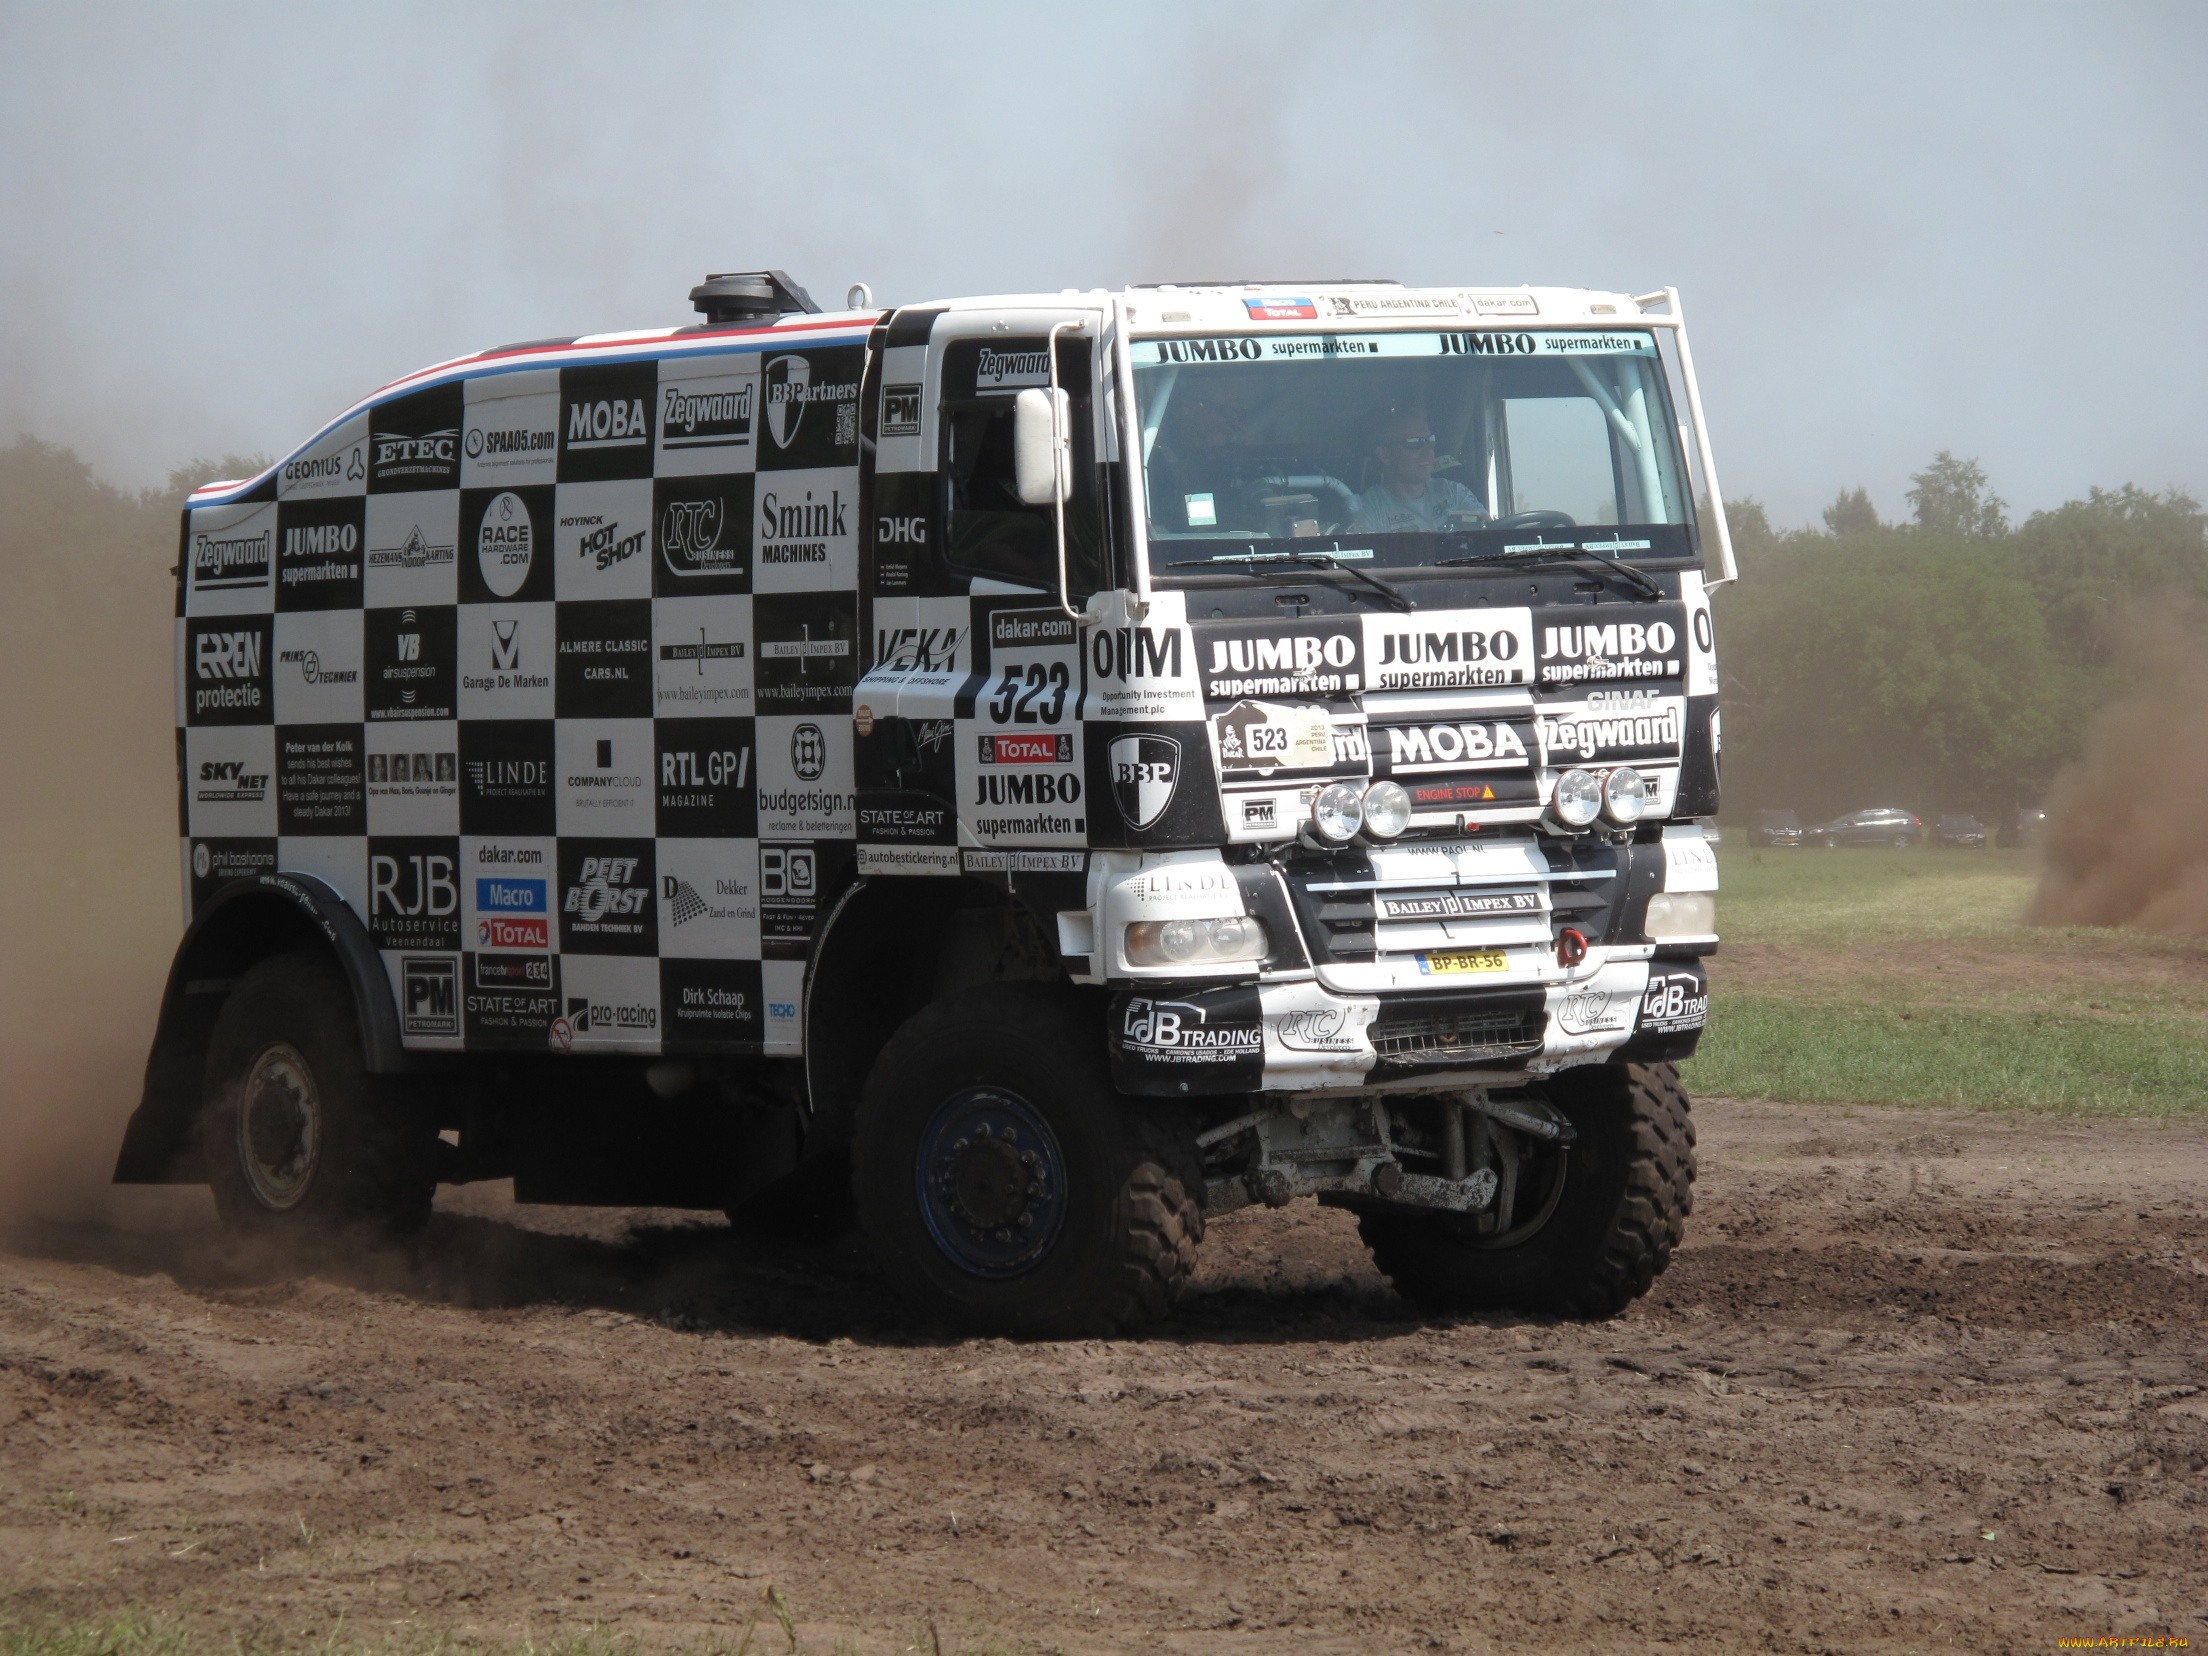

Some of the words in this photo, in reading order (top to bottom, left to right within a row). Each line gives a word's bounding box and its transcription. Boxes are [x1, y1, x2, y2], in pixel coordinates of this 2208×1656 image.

[1354, 299, 1378, 309] PERU
[1380, 299, 1430, 309] ARGENTINA
[1432, 299, 1457, 308] CHILE
[1477, 298, 1532, 308] dakar.com
[1156, 339, 1262, 364] JUMBO
[1272, 340, 1365, 357] supermarkten
[1439, 334, 1536, 355] JUMBO
[1545, 336, 1631, 351] supermarkten
[665, 384, 752, 432] Zegwaard
[884, 396, 919, 423] PM
[568, 399, 646, 439] MOBA
[375, 439, 456, 465] ETEC
[560, 515, 603, 527] HOYINCK
[762, 491, 847, 539] Smink
[482, 525, 528, 543] RACE
[667, 500, 715, 555] RTC
[283, 524, 357, 557] JUMBO
[482, 544, 528, 553] HARDWARE
[580, 522, 618, 557] HOT
[196, 530, 270, 575] Zegwaard
[401, 557, 426, 568] INDOOR
[426, 549, 454, 560] KARTING
[500, 553, 529, 565] .COM
[596, 530, 646, 570] SHOT
[762, 544, 826, 563] MACHINES
[282, 562, 348, 587] supermarkten
[996, 619, 1072, 639] dakar.com
[397, 634, 421, 661] VB
[559, 641, 602, 653] ALMERE
[605, 639, 648, 652] CLASSIC
[774, 645, 799, 655] BAILEY
[810, 644, 833, 654] IMPEX
[835, 642, 846, 653] BV
[1378, 630, 1519, 665] JUMBO
[1541, 622, 1676, 658] JUMBO
[196, 631, 261, 679] ERREN
[672, 647, 697, 658] BAILEY
[706, 646, 729, 657] IMPEX
[730, 645, 742, 656] BV
[876, 628, 957, 672] VEKA
[1209, 635, 1356, 673] JUMBO
[280, 650, 304, 663] PRINS
[319, 671, 357, 684] TECHNIEK
[383, 664, 436, 681] airsuspension
[584, 668, 629, 680] CARS.NL
[1542, 657, 1663, 682] supermarkten
[463, 675, 495, 691] Garage
[498, 675, 511, 688] De
[513, 675, 549, 688] Marken
[1210, 674, 1341, 697] supermarkten
[1379, 665, 1505, 689] supermarkten
[197, 683, 261, 713] protectie
[657, 686, 749, 703] www.baileyimpex.com
[757, 683, 853, 702] www.baileyimpex.com
[990, 662, 1069, 725] 523
[1102, 690, 1141, 701] Opportunity
[1143, 690, 1195, 699] Investment
[1588, 689, 1659, 712] GINAF
[1101, 706, 1148, 716] Management
[1151, 706, 1165, 715] plc
[1253, 728, 1288, 751] 523
[1385, 722, 1527, 763] MOBA
[1544, 707, 1679, 759] Zegwaard
[285, 742, 305, 752] Peter
[307, 744, 320, 752] van
[322, 741, 334, 752] der
[336, 741, 352, 751] Kolk
[998, 740, 1053, 757] TOTAL
[287, 759, 305, 768] sends
[307, 758, 316, 768] his
[317, 758, 330, 768] best
[331, 758, 352, 767] wishes
[486, 761, 547, 784] LINDE
[662, 752, 704, 786] RTL
[200, 762, 244, 781] SKY
[237, 775, 269, 789] NET
[297, 774, 306, 784] his
[307, 774, 326, 784] Dakar
[568, 776, 642, 788] COMPANYCLOUD
[198, 792, 234, 800] WORLDWIDE
[975, 773, 1081, 805] JUMBO
[1417, 788, 1453, 800] ENGINE
[1456, 787, 1480, 798] STOP
[663, 795, 714, 807] MAGAZINE
[293, 806, 313, 819] steady
[314, 806, 333, 816] Dakar
[860, 810, 901, 824] STATE
[903, 811, 914, 819] OF
[916, 811, 944, 824] ART
[1245, 806, 1274, 821] PM
[769, 821, 796, 831] reclame
[806, 820, 851, 833] beletteringen
[977, 814, 1071, 839] supermarkten
[479, 846, 542, 864] dakar.com
[868, 851, 958, 868] autobestickering.nl
[967, 854, 1004, 868] BAILEY
[1022, 854, 1058, 868] IMPEX
[1062, 854, 1079, 868] BV
[579, 857, 638, 883] PEET
[371, 855, 457, 916] RJB
[716, 880, 748, 896] Dekker
[1150, 875, 1230, 892] LINDE
[490, 884, 533, 906] Macro
[564, 878, 649, 922] BORST
[1388, 899, 1441, 916] BAILEY
[1462, 896, 1513, 912] IMPEX
[1516, 893, 1536, 909] BV
[709, 907, 726, 919] Zand
[727, 910, 736, 918] en
[736, 907, 756, 919] Grind
[372, 918, 458, 932] Autoservice
[493, 922, 546, 944] TOTAL
[572, 923, 599, 932] BANDEN
[601, 924, 632, 934] TECHNIEK
[634, 925, 643, 934] BV
[386, 936, 444, 947] Veenendaal
[1432, 954, 1503, 970] BP-BR-56
[407, 977, 452, 1015] PM
[467, 996, 512, 1013] STATE
[514, 998, 526, 1006] OF
[528, 998, 557, 1014] ART
[683, 988, 705, 1005] Dirk
[707, 989, 744, 1009] Schaap
[591, 1003, 656, 1028] pro-racing
[677, 1008, 712, 1019] Kruipruimte
[713, 1009, 734, 1018] Isolatie
[736, 1009, 751, 1020] Chips
[1562, 991, 1606, 1024] RTC
[408, 1020, 450, 1028] PETROMARK
[481, 1017, 508, 1026] FASHION
[519, 1018, 547, 1028] PASSION
[1282, 1010, 1338, 1041] RTC
[1181, 1028, 1262, 1046] TRADING
[1137, 1045, 1159, 1054] TRUCKS
[1145, 1053, 1236, 1063] WWW.JBTRADING.COM
